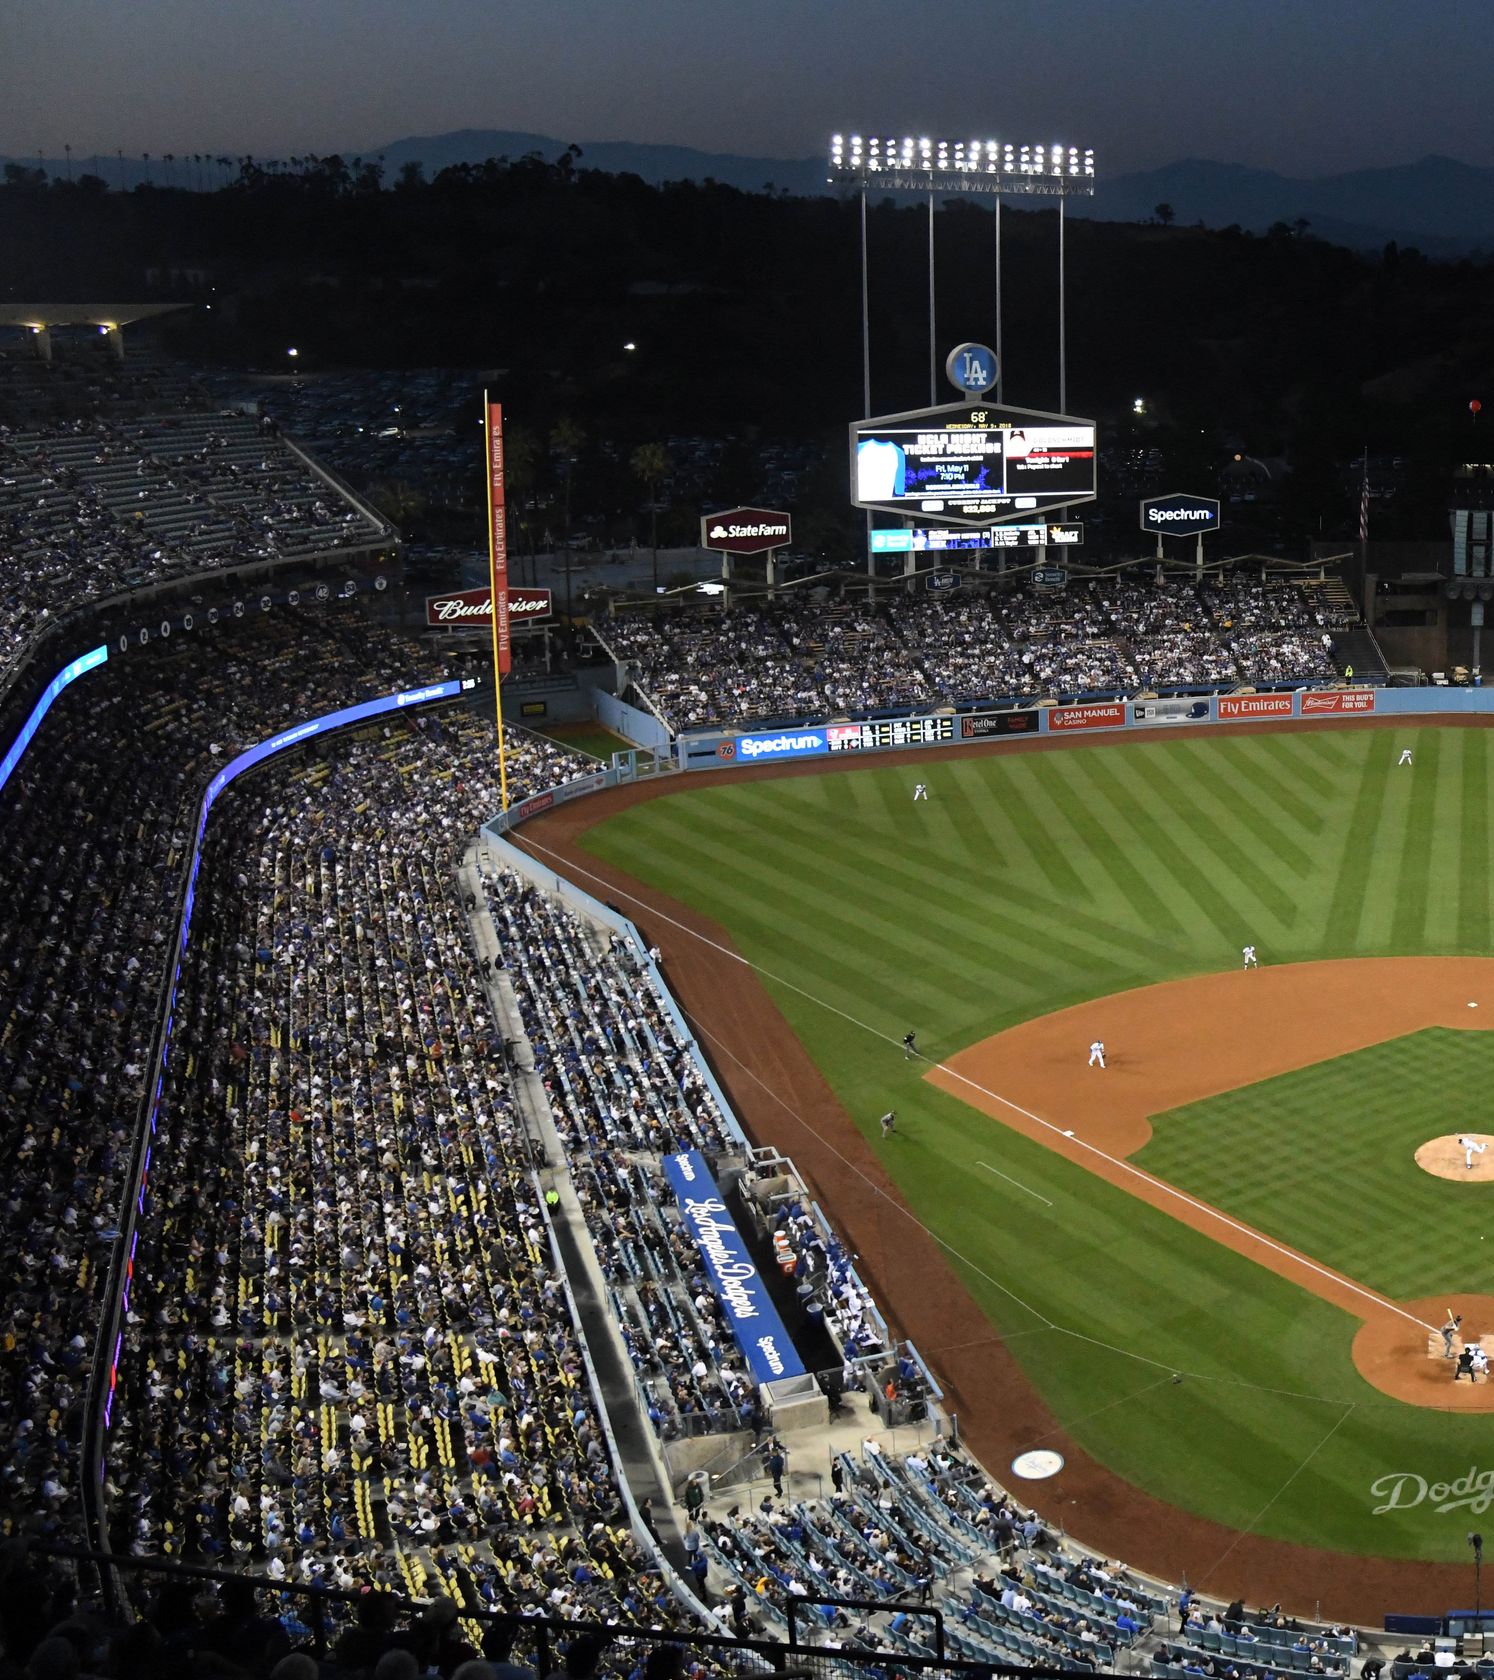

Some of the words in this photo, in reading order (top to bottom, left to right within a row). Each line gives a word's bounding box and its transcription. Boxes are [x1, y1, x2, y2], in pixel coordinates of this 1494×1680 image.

[964, 353, 987, 385] LA
[903, 444, 945, 455] TICKET
[946, 443, 1001, 455] PACKAGE
[947, 465, 963, 474] May
[1148, 507, 1210, 523] Spectrum
[1063, 711, 1080, 720] SAN
[1083, 707, 1121, 718] MANUEL
[1220, 702, 1239, 715] Fly
[1241, 698, 1291, 713] Emirates
[983, 719, 997, 728] One
[1063, 718, 1087, 726] CASINO
[719, 745, 733, 755] 76
[741, 734, 818, 757] Spectrum
[676, 1153, 696, 1182] Spectrum
[694, 1217, 738, 1266] Angeles
[714, 1262, 760, 1319] Dodgers
[758, 1335, 785, 1376] Spectrum
